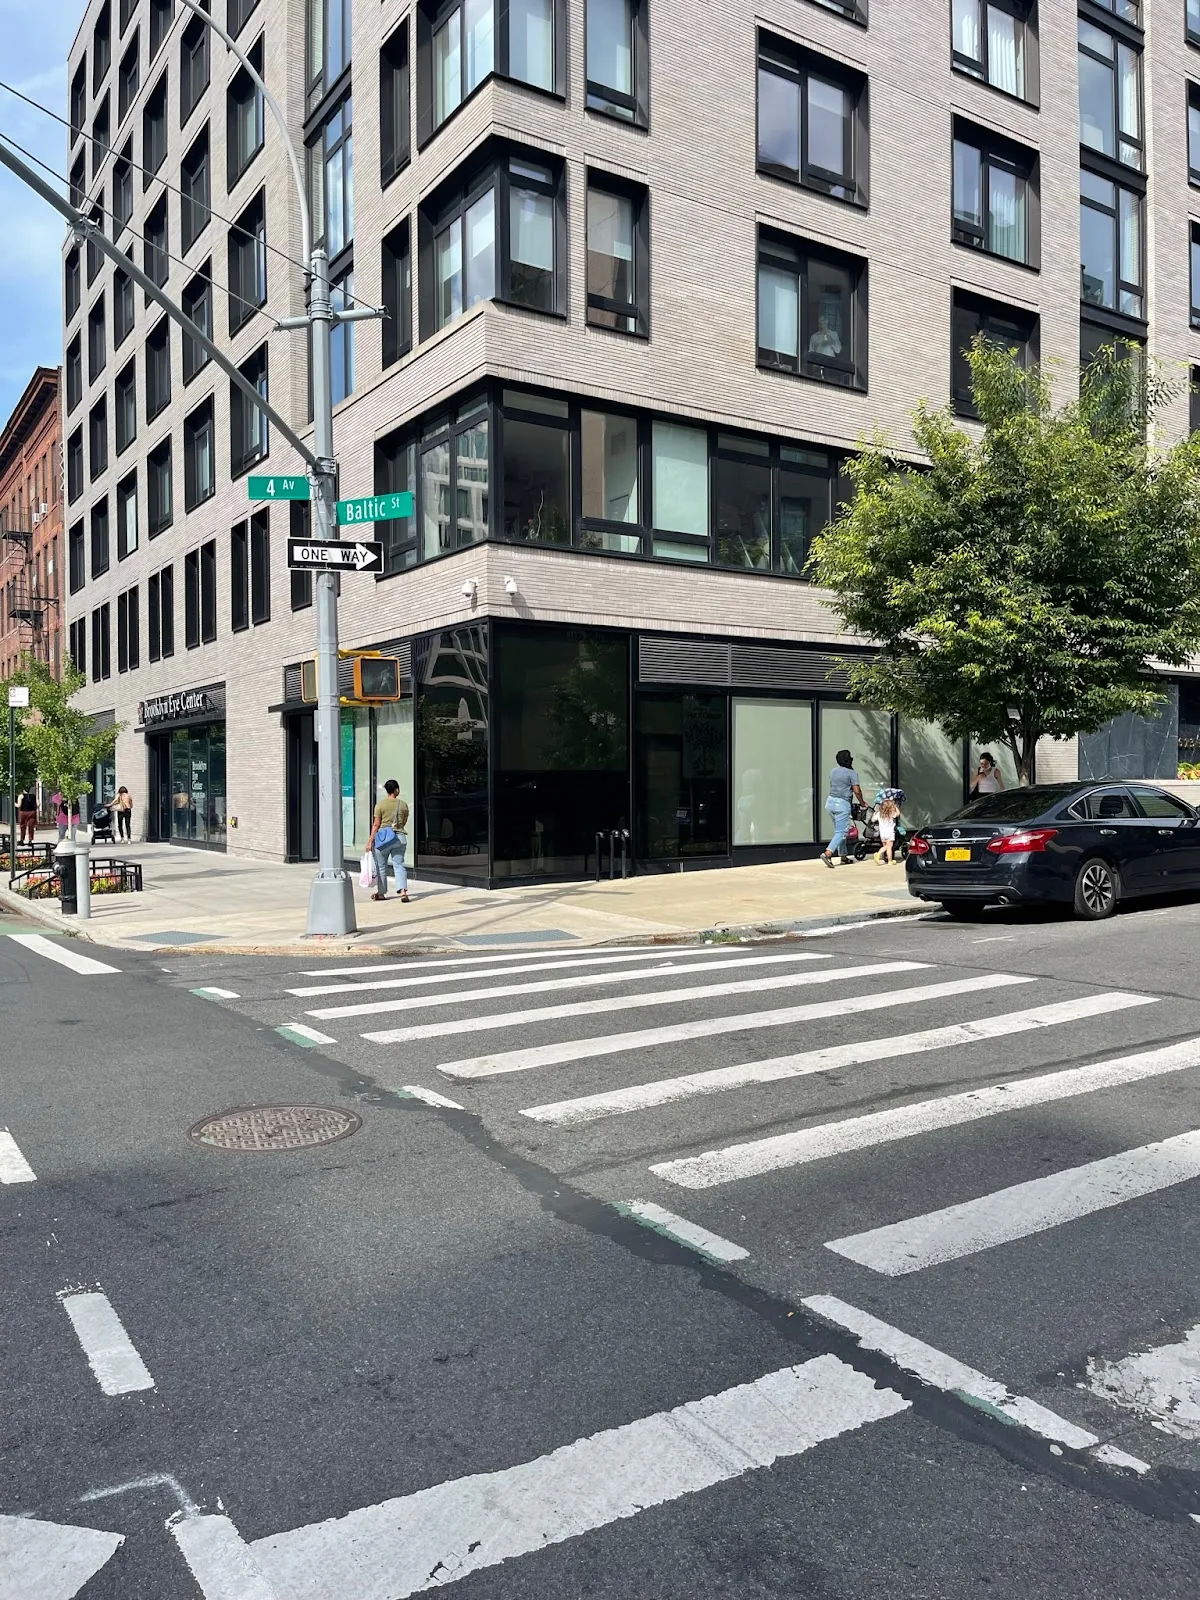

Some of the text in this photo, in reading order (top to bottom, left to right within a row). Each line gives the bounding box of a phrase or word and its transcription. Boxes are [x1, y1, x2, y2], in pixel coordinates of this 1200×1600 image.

[266, 479, 275, 496] 4
[346, 497, 400, 521] Baltic St
[301, 548, 368, 562] ONE WAY
[144, 692, 203, 720] Brooklyn Eye Center
